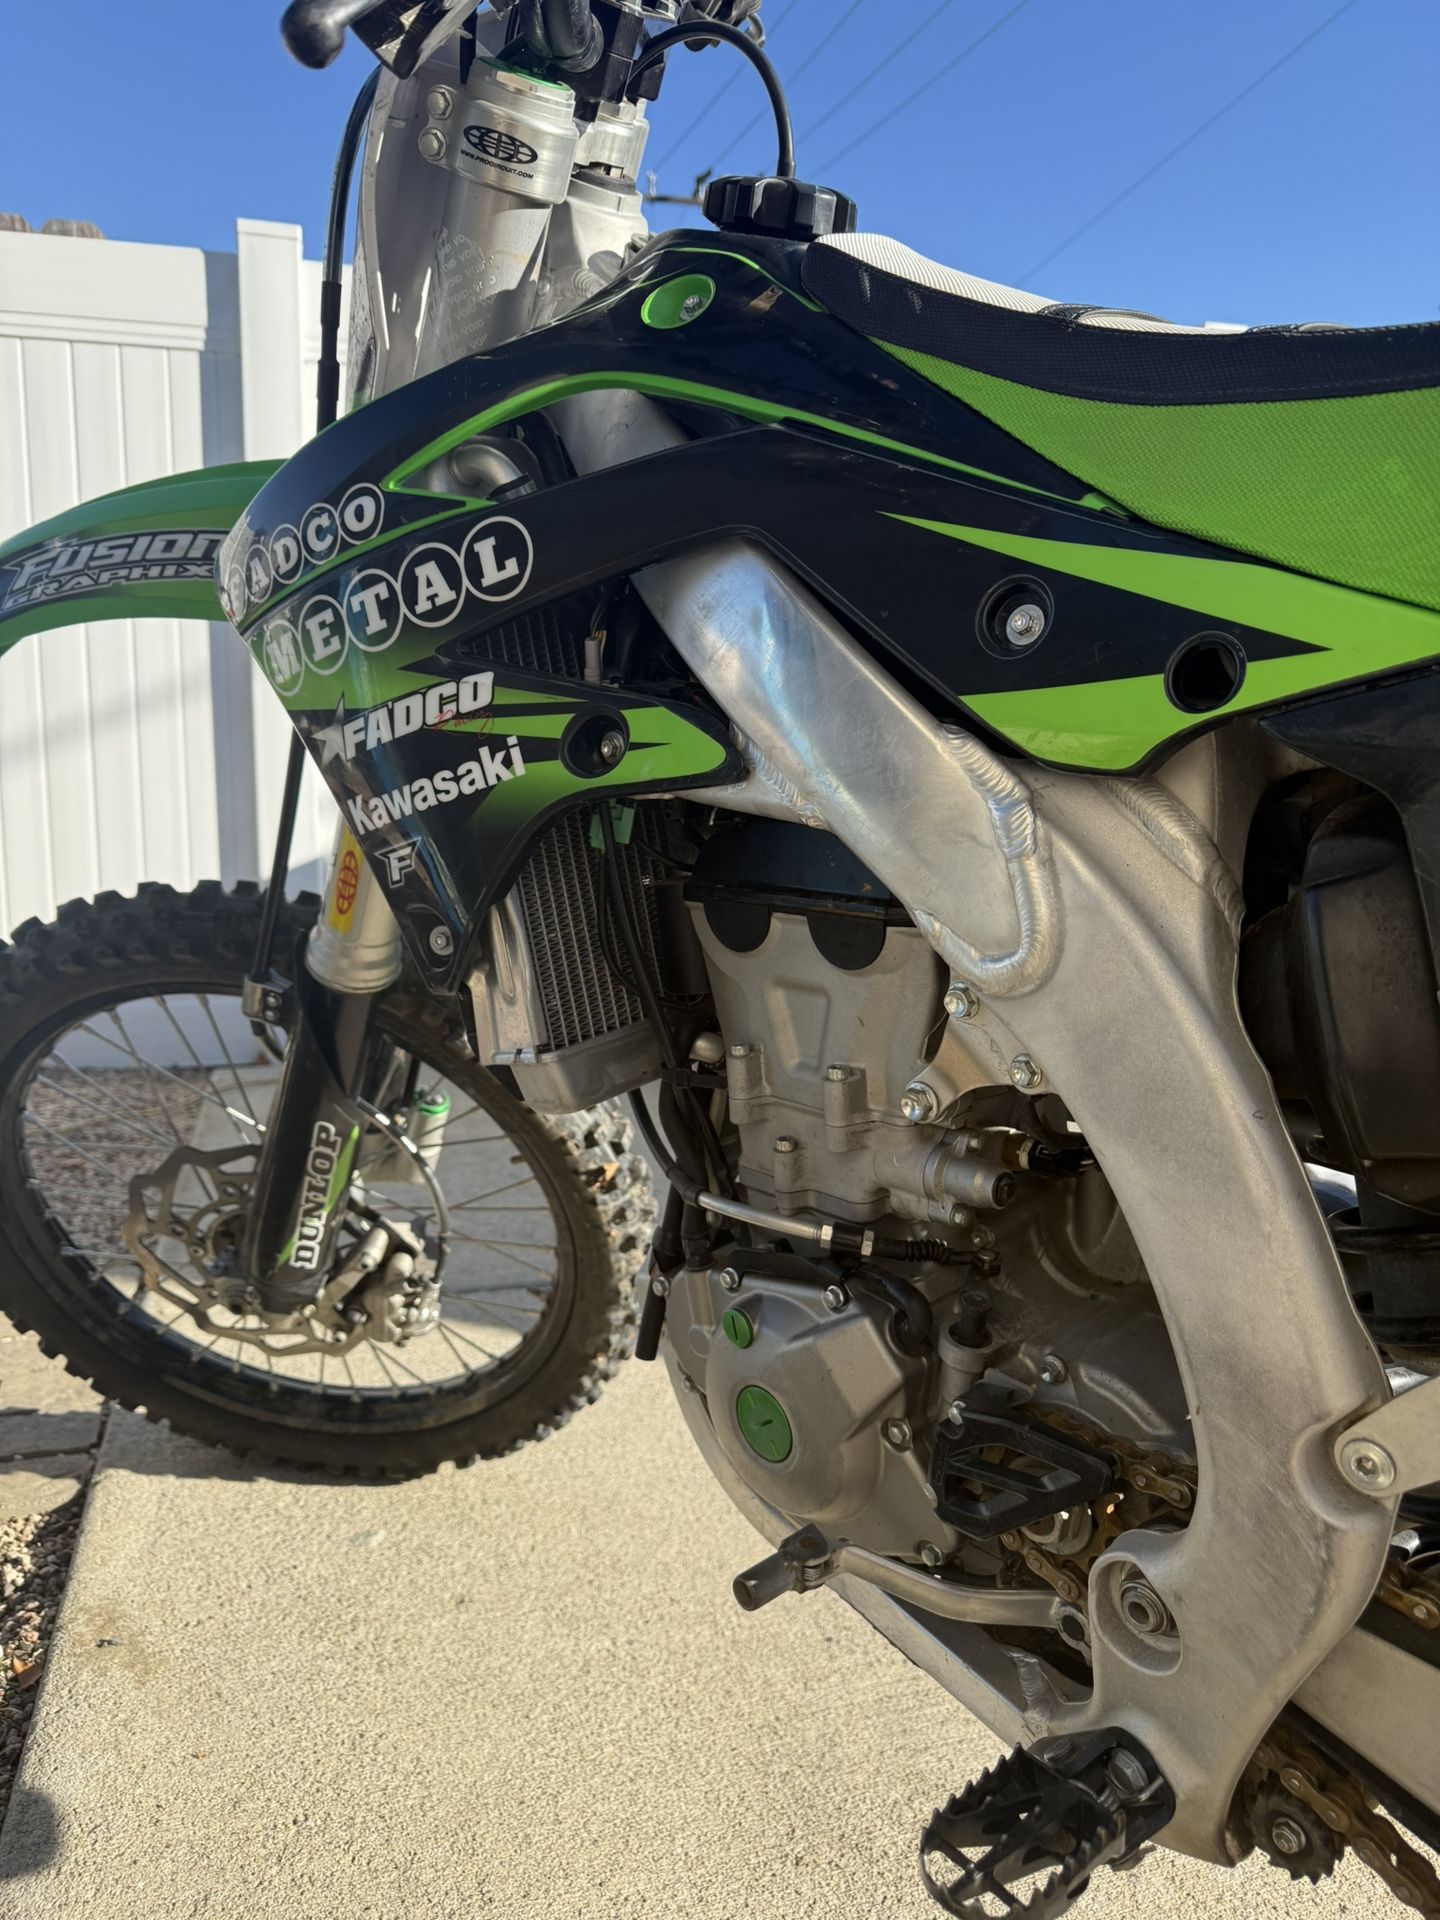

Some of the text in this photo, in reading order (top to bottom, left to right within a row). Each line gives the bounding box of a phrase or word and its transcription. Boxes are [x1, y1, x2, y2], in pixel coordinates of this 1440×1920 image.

[2, 563, 214, 610] GRAPHIX
[12, 530, 226, 592] FUSION
[266, 536, 520, 684] METAL
[341, 672, 495, 763] FADCO
[347, 735, 527, 836] Kawasaki
[289, 1120, 342, 1270] DUNLOP
